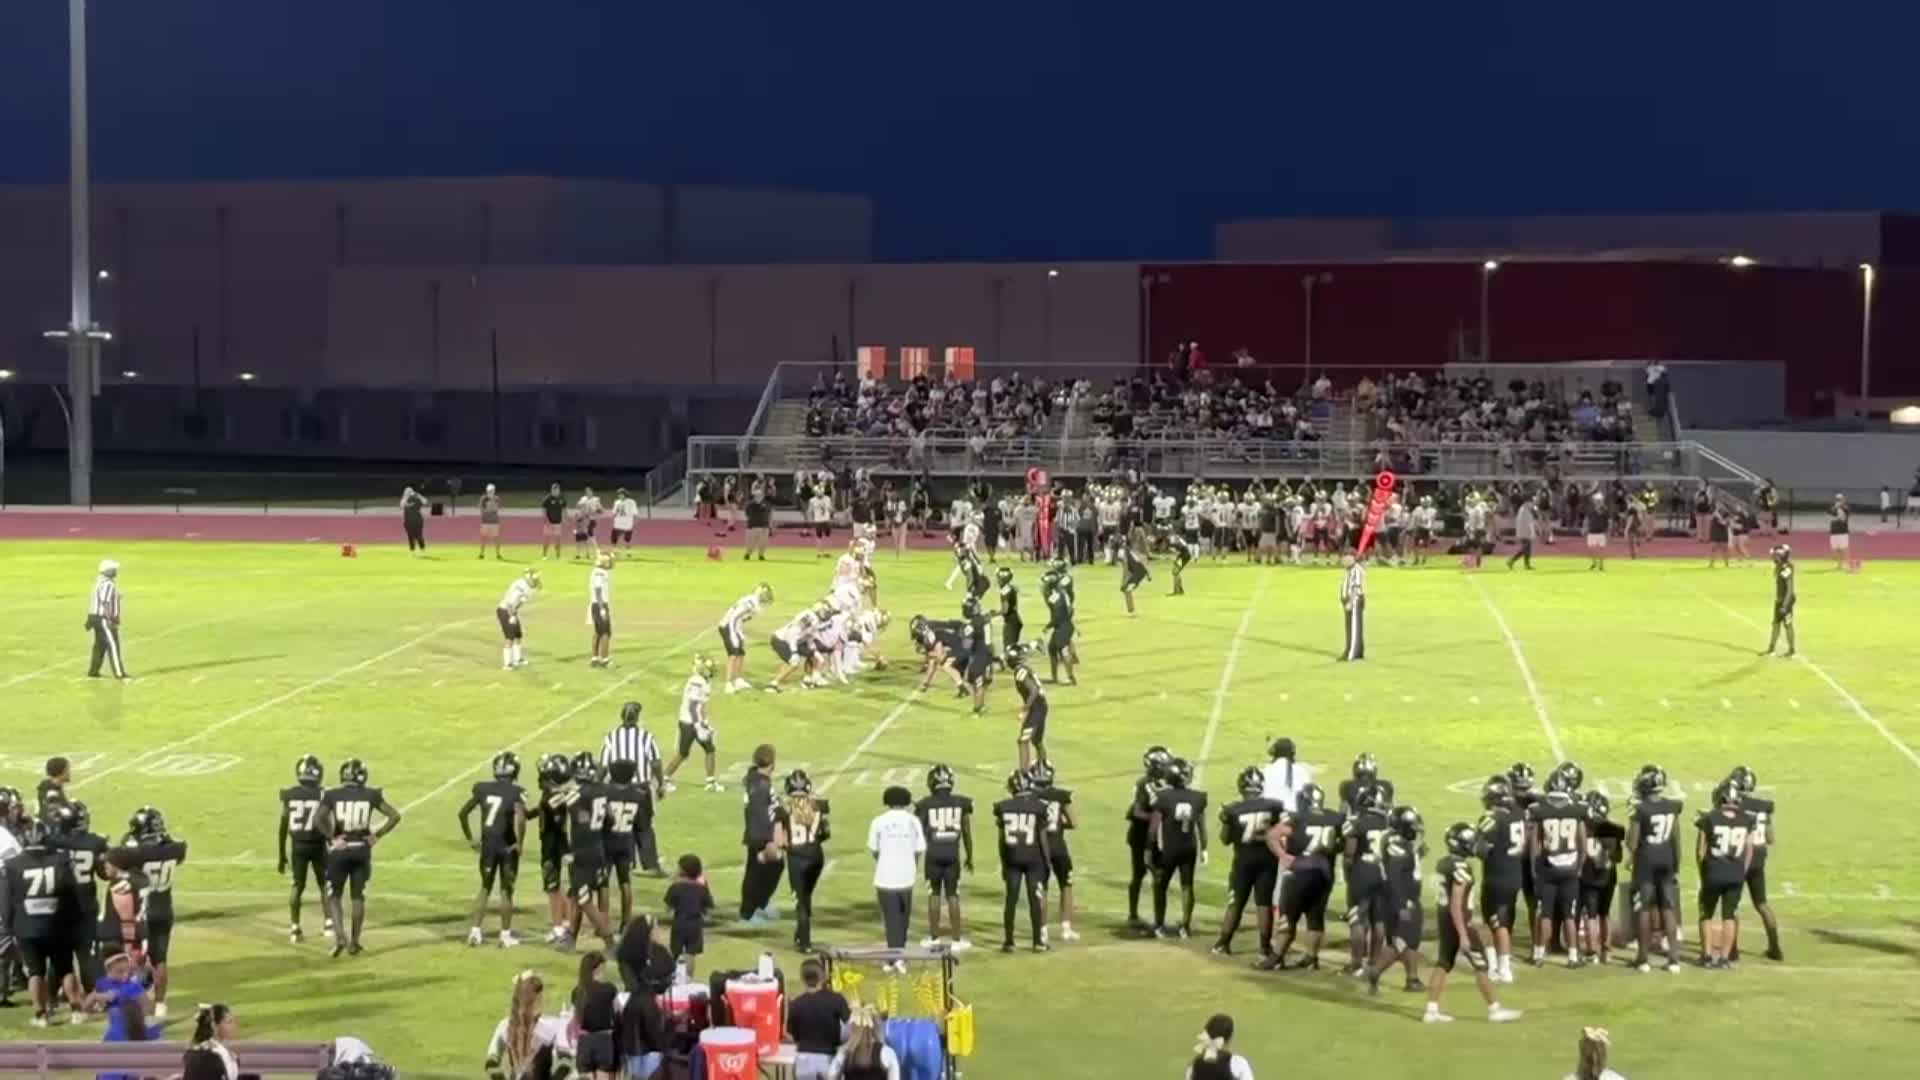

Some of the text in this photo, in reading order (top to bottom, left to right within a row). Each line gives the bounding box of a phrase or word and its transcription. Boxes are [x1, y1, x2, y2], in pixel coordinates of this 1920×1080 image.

[289, 800, 319, 831] 27
[336, 801, 370, 831] 40
[485, 796, 503, 827] 7
[928, 807, 962, 831] 44
[1004, 813, 1035, 845] 24
[1543, 818, 1577, 851] 99
[1647, 813, 1675, 844] 31
[1711, 825, 1747, 857] 39
[23, 866, 55, 896] 71
